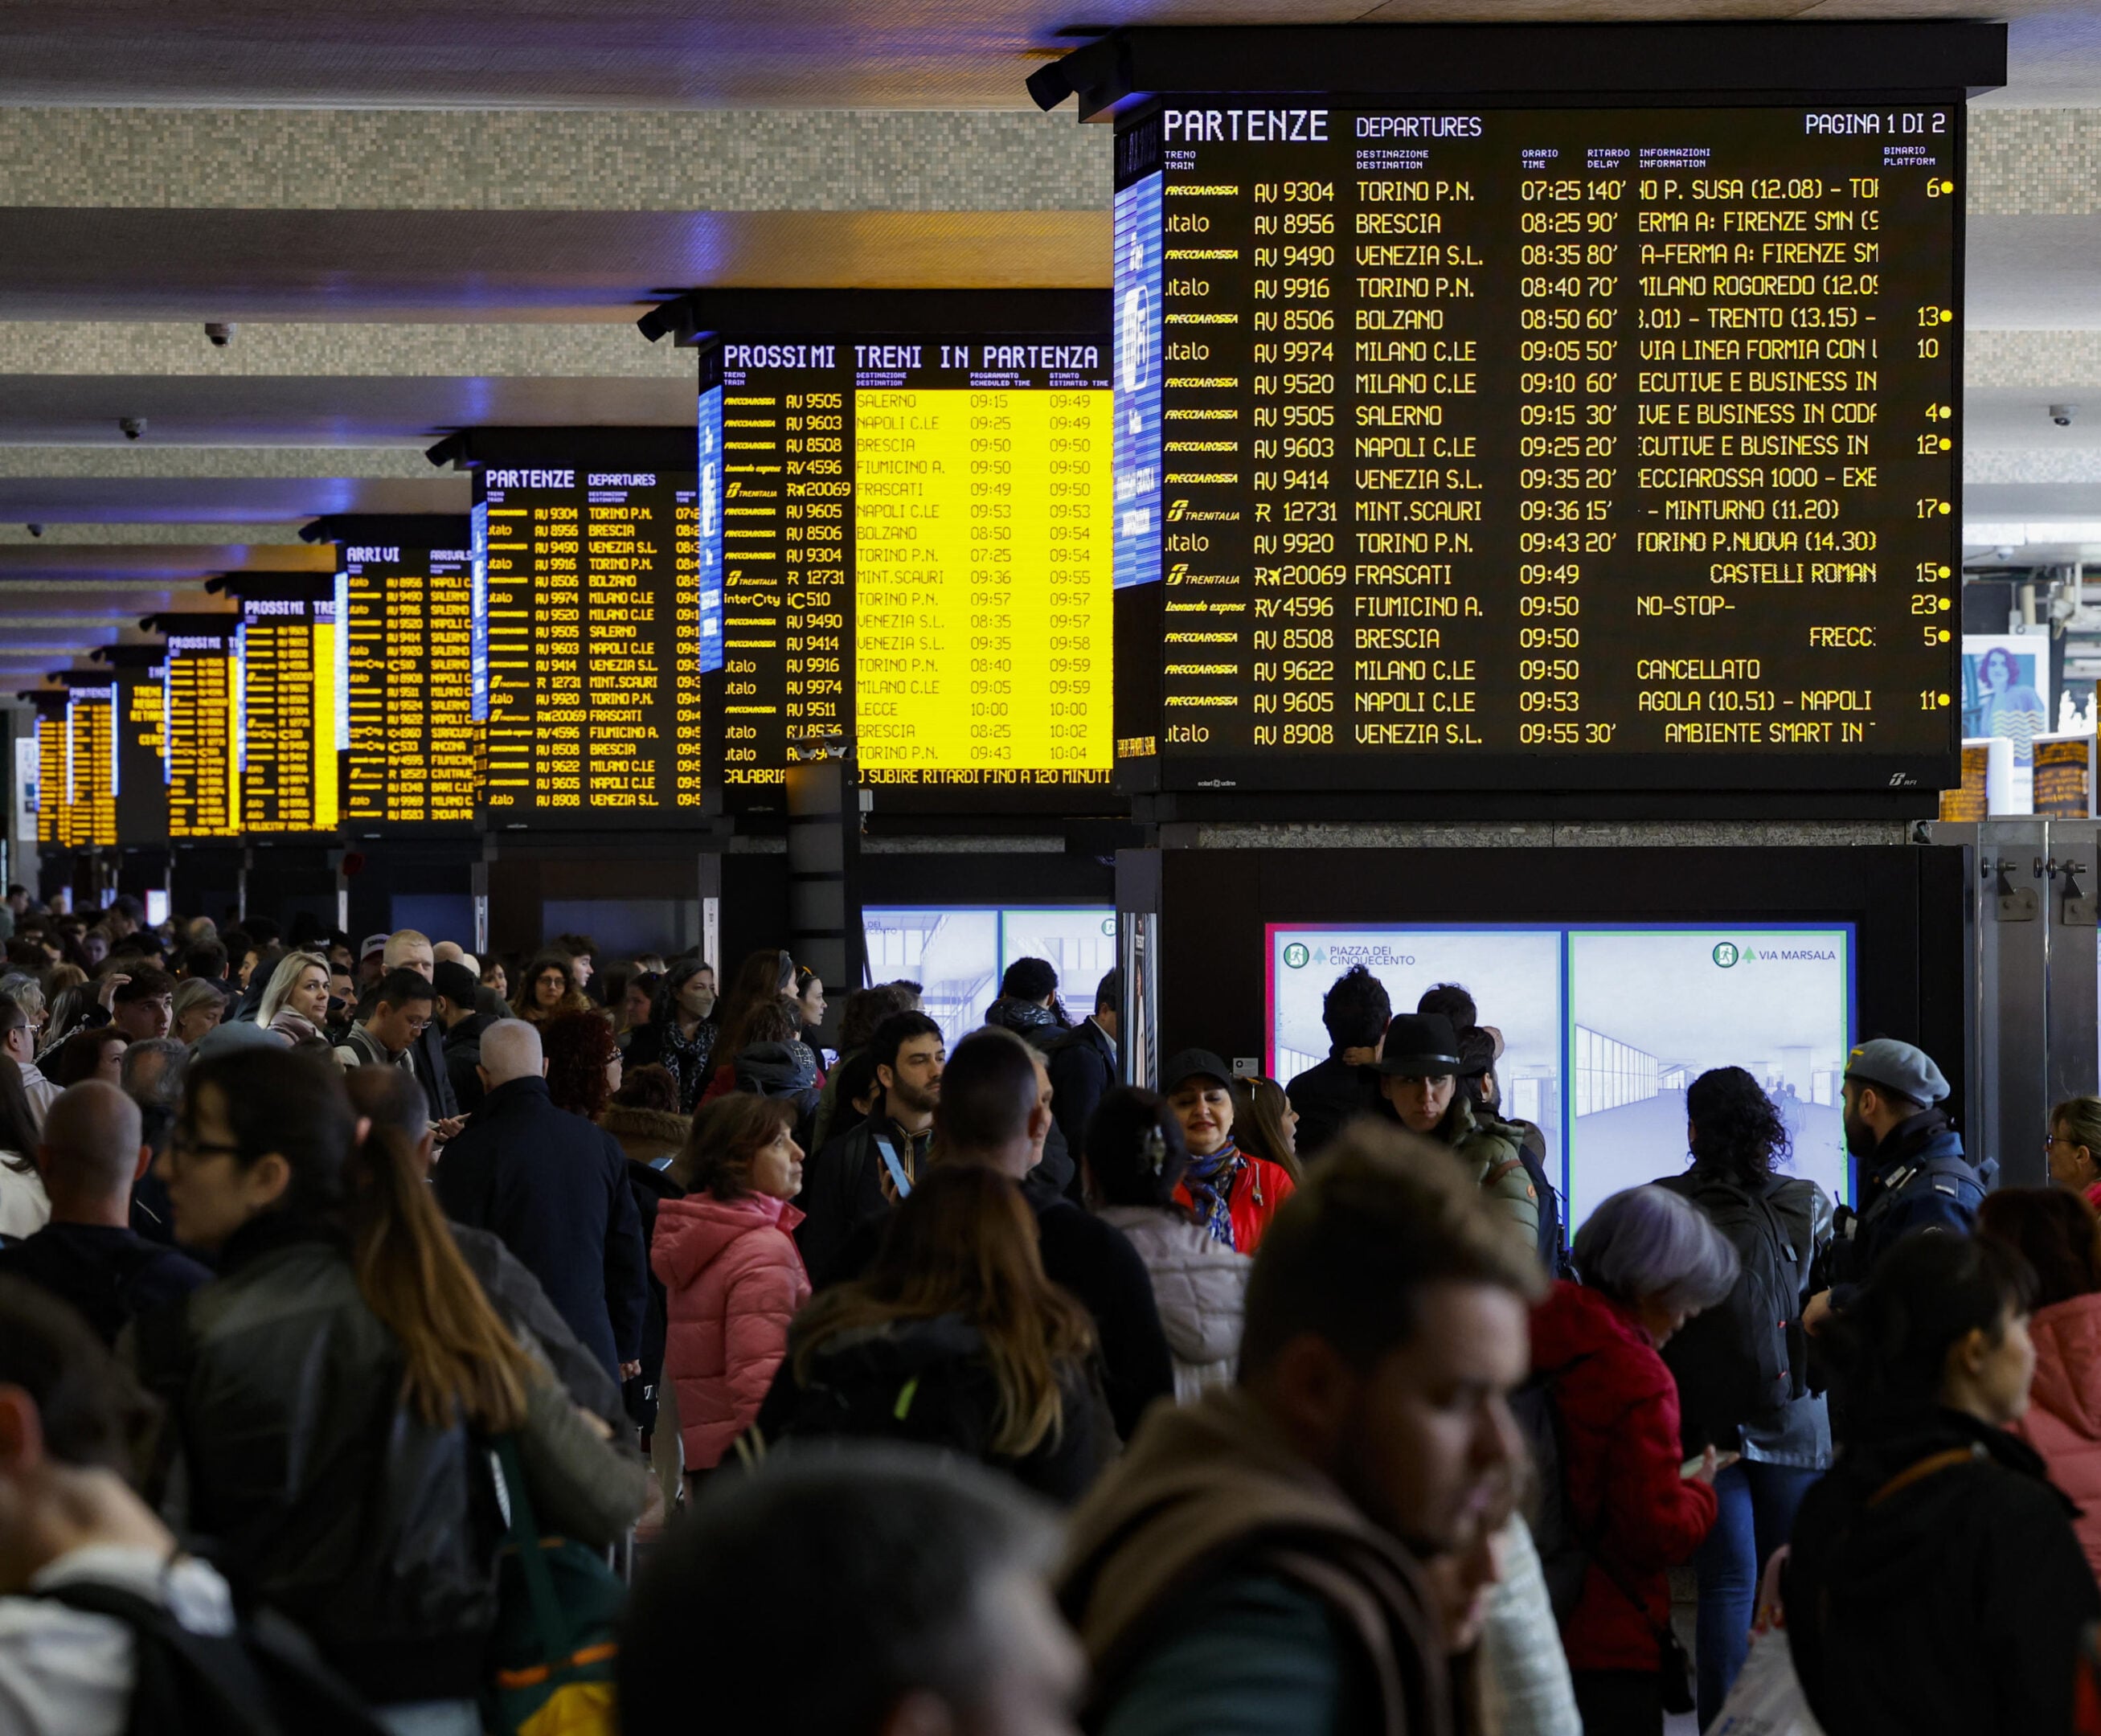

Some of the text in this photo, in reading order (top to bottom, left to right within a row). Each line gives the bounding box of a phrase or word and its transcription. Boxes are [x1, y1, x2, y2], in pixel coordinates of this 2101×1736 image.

[1164, 109, 1945, 141] PARTENZE DEPARTURES PAGINA 1 DI 2
[1165, 147, 1926, 158] TRENO DESTINAZIONE ORARIO RITARDO INFORMAZIONI BINARIO
[1165, 158, 1936, 170] TRAIN DESTINATION TIME DELAY INFORMATION PLATFORM
[1255, 183, 1278, 203] AV
[1284, 182, 1335, 202] 9304
[1357, 181, 1429, 202] TORINO
[1436, 181, 1475, 202] P.N.
[1521, 180, 1581, 201] 07:25
[1587, 180, 1627, 201] 140'
[1692, 179, 1743, 200] SUSA
[1751, 178, 1822, 199] (12.08)
[1927, 178, 1939, 198] 6
[1255, 211, 1853, 235] AV 8956 BRESCIA 08:25 90' FIRENZE SMN
[1284, 306, 1939, 330] 8506 BOLZANO 08:50 TRENTO (13.15) 13
[723, 346, 1098, 369] PROSSIMI TRENI IN PARTENZA
[1255, 338, 1939, 364] AV 9974 MILANO C.LE 09:05 VIA LINEA FORMIA CON 10
[855, 371, 907, 379] DESTINAZIONE
[806, 394, 1091, 409] 9505 SALERNO 09:15 09:49
[786, 437, 1091, 453] AV 8508 BRESCIA 09:50 09:50
[485, 469, 657, 489] PARTENZE DEPARTURES
[550, 507, 629, 521] 9304 TORINO
[1185, 498, 1938, 522] TRENITALIA R 12731 MINT.SCAURI 09:36 15' MINTURNO (11.20) 17
[534, 524, 635, 538] AV 8956 BRESCIA
[806, 526, 1091, 541] 8506 BOLZANO 08:50 09:54
[346, 547, 473, 563] ARRIVI ARRIVALS
[550, 575, 637, 588] 8506 BOLZANO
[1355, 563, 1938, 585] FRASCATI 09:49 CASTELLI 15
[806, 592, 1011, 607] 510 TORINO 09:57
[1165, 595, 1938, 618] Leonardo express RV 4596 FIUMICINO 09:50 NO-STOP- 23
[1283, 660, 1334, 681] 9622
[1355, 660, 1427, 681] MILANO
[1432, 660, 1476, 681] C.LE
[1520, 660, 1579, 681] 09:50
[1636, 659, 1760, 680] CANCELLATO
[551, 676, 657, 689] 12731 MINT.SCAURI
[806, 702, 1009, 717] 9511 LECCE 10:00
[1283, 722, 1833, 744] 8908 VENEZIA S.L. 09:55 AMBIENTE SMART
[869, 771, 1111, 784] SUBIRE RITARDI FINO A 120 MINUTI
[590, 793, 637, 806] VENEZIA
[1329, 946, 1391, 956] PIAZZA DEI
[1759, 951, 1837, 960] VIA MARSALA
[1329, 955, 1415, 966] CINQUECENTO
